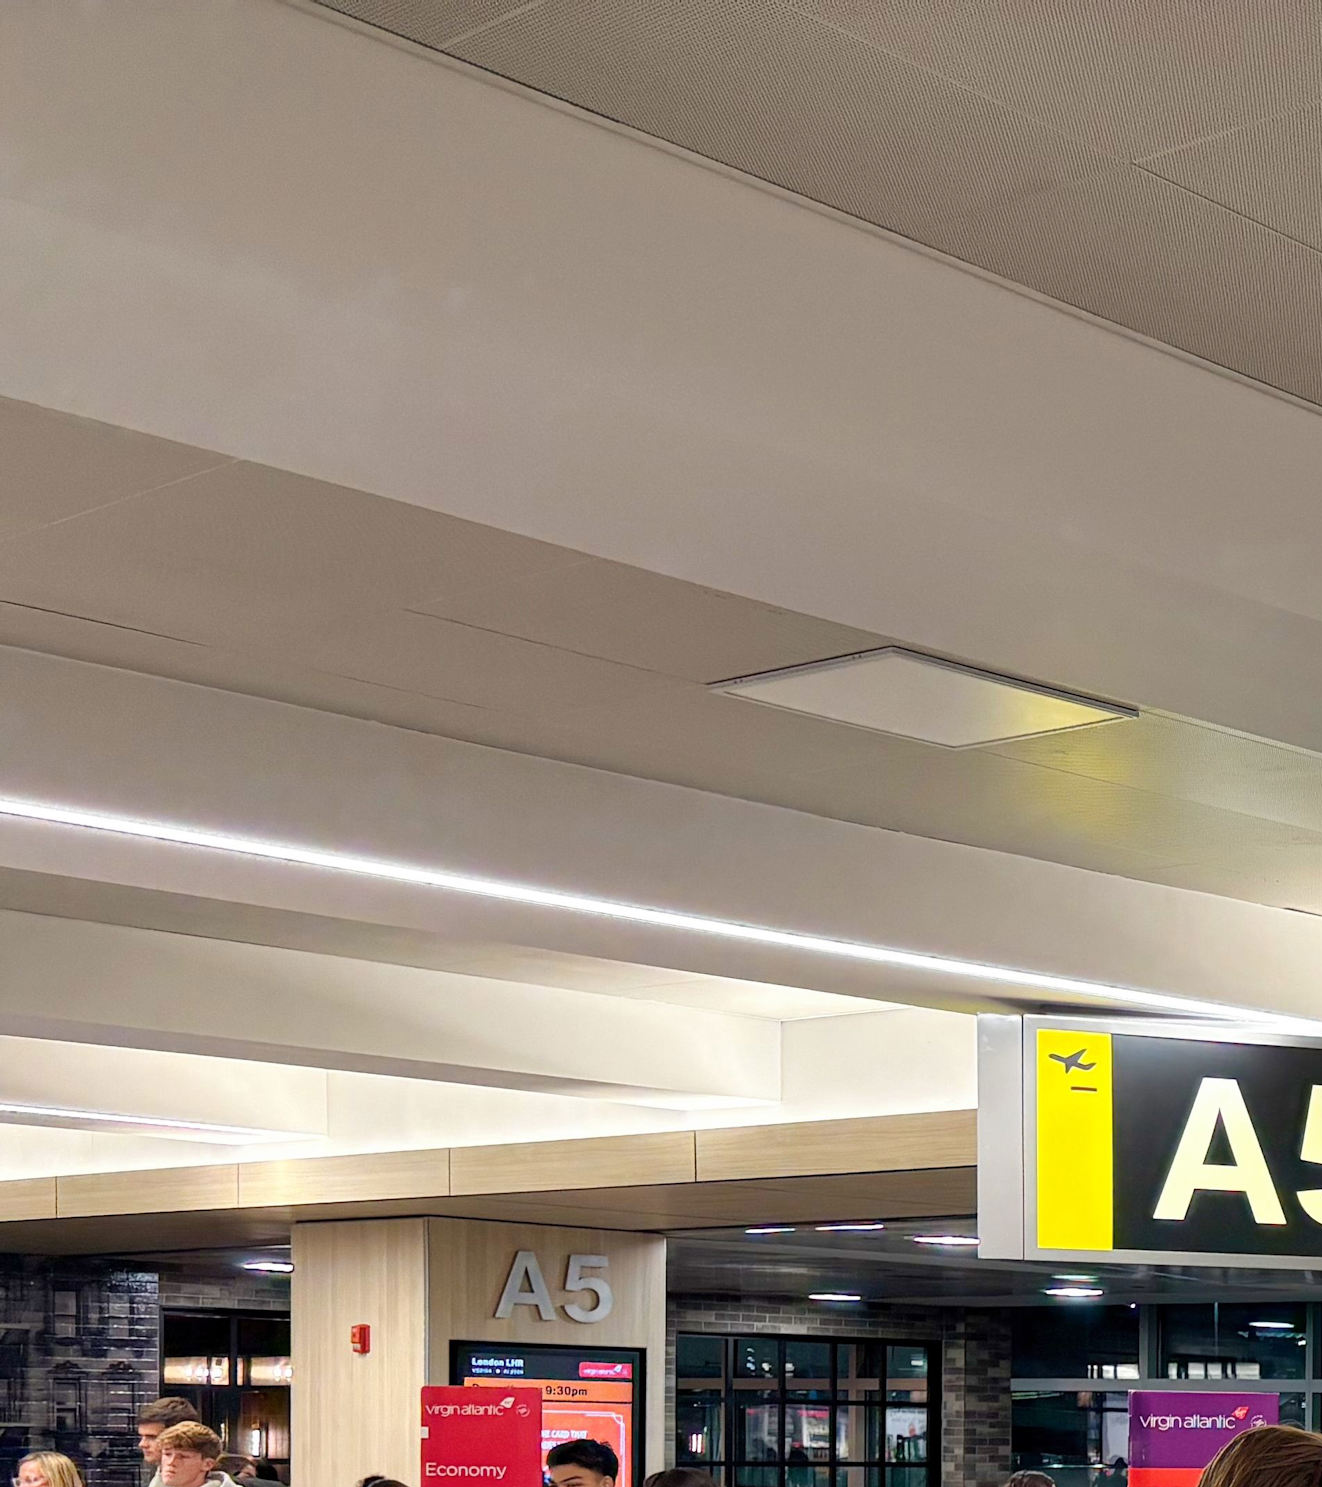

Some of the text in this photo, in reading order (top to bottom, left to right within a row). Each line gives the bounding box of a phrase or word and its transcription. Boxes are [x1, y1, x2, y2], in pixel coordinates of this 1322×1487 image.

[494, 1250, 614, 1323] A5
[471, 1358, 504, 1367] London
[545, 1386, 588, 1397] 9:30pm
[425, 1404, 505, 1418] virgin atlantic
[1139, 1414, 1236, 1431] virgin atlantic
[425, 1462, 507, 1479] Economy
